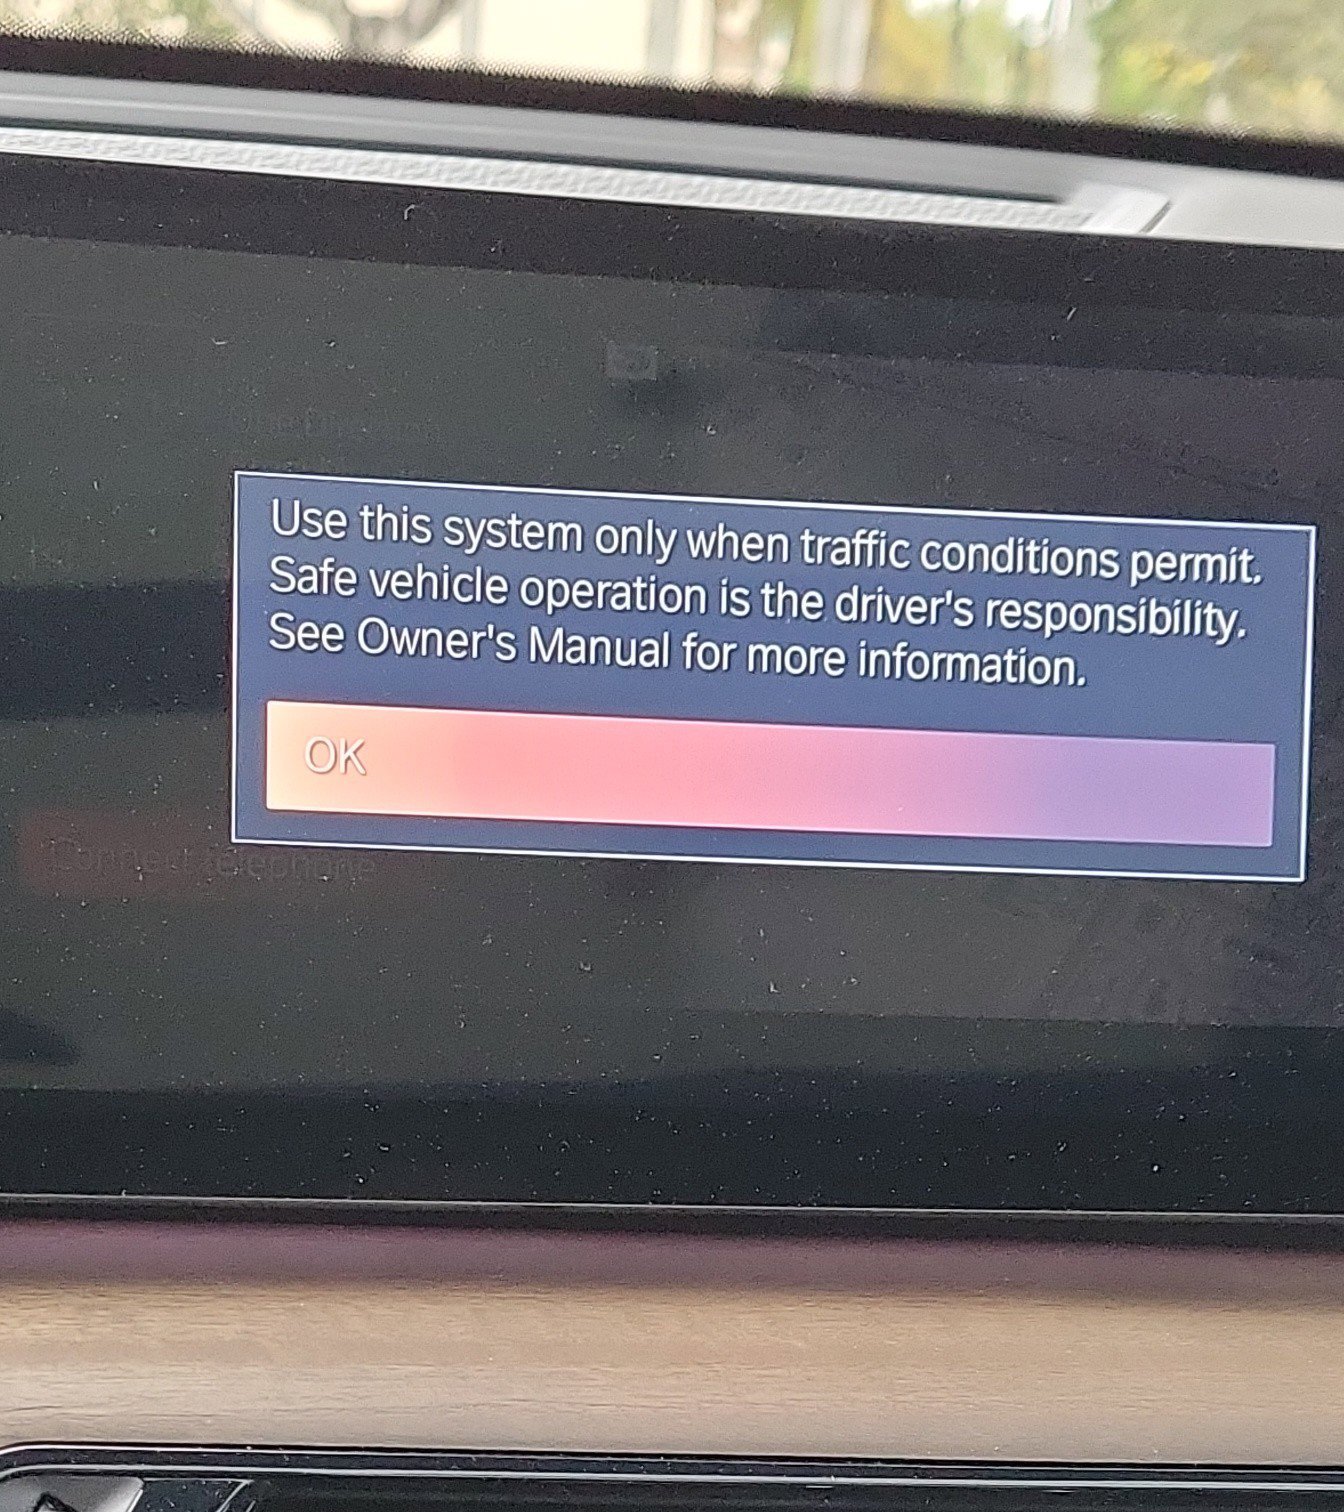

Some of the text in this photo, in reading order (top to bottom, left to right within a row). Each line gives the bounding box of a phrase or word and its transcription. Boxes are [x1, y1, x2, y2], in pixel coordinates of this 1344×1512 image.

[271, 499, 1262, 587] Use this system only when traffic conditions permit.
[269, 556, 1247, 645] Safe vehicle operation is the driver's responsibility.
[268, 613, 1086, 686] See Owner's Manual for more information.
[304, 736, 366, 776] OK
